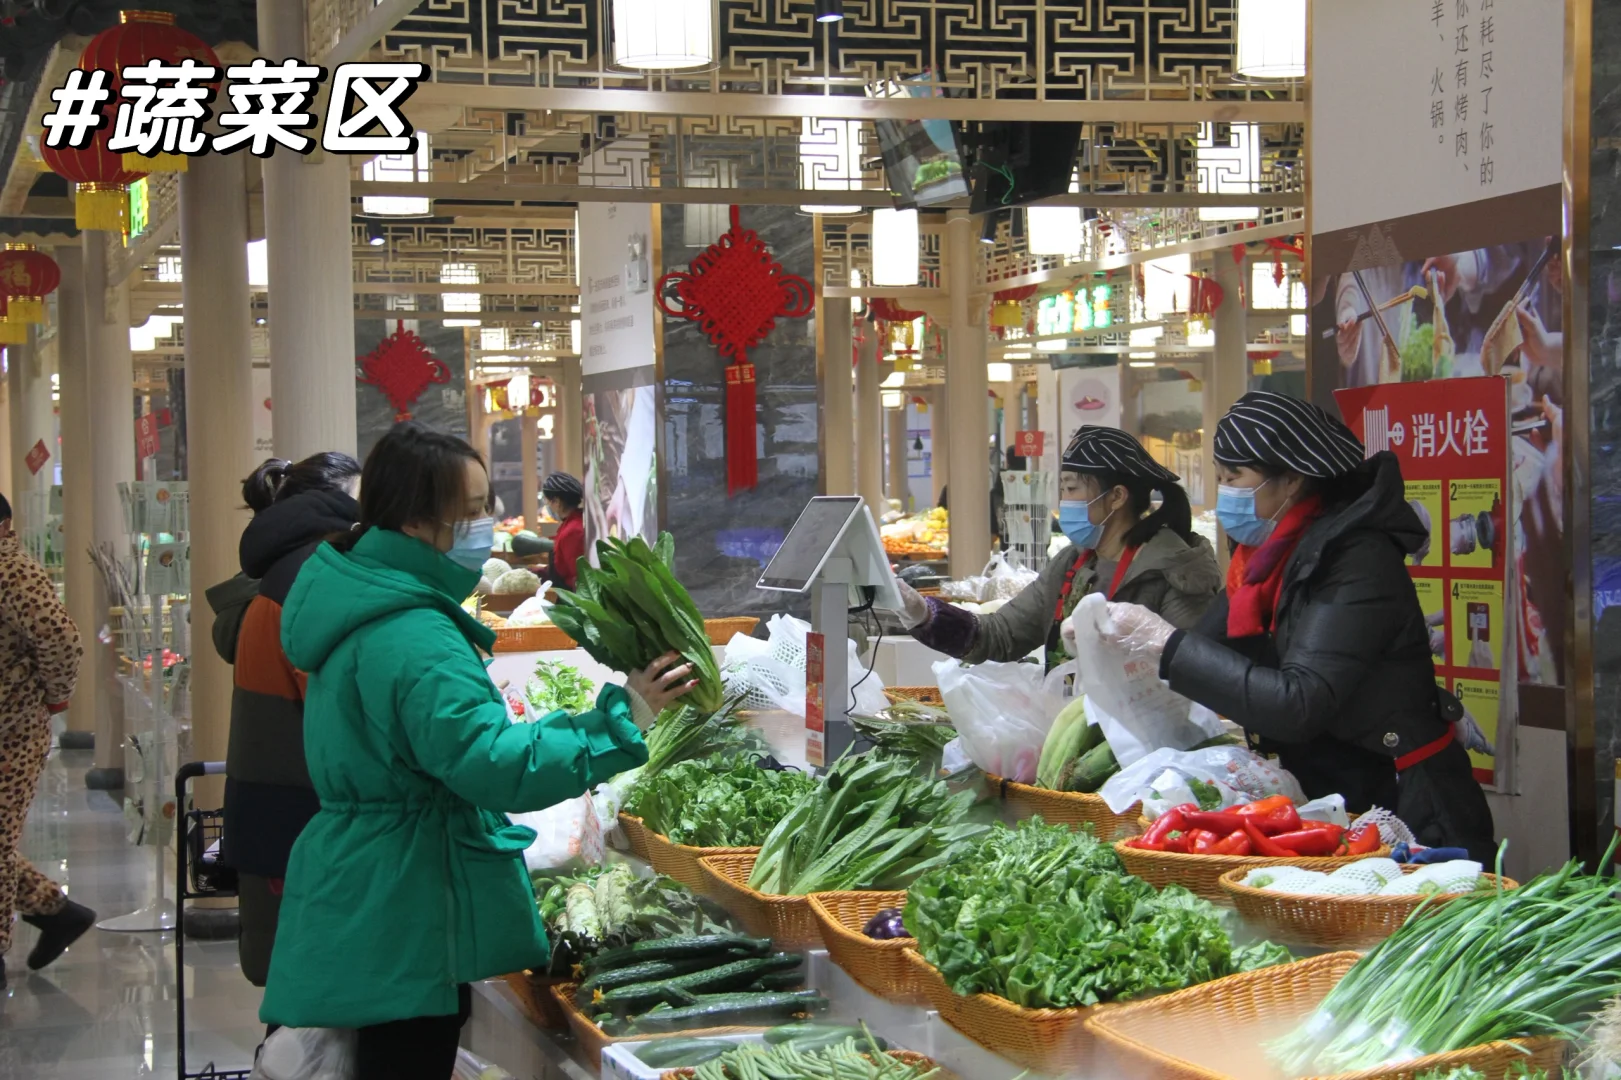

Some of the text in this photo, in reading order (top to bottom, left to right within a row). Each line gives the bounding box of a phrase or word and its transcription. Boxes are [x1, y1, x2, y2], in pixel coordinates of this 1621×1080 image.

[1411, 409, 1489, 457] 消火栓
[1450, 483, 1457, 501] 2
[1452, 582, 1460, 600] 4
[1456, 682, 1463, 700] 6
